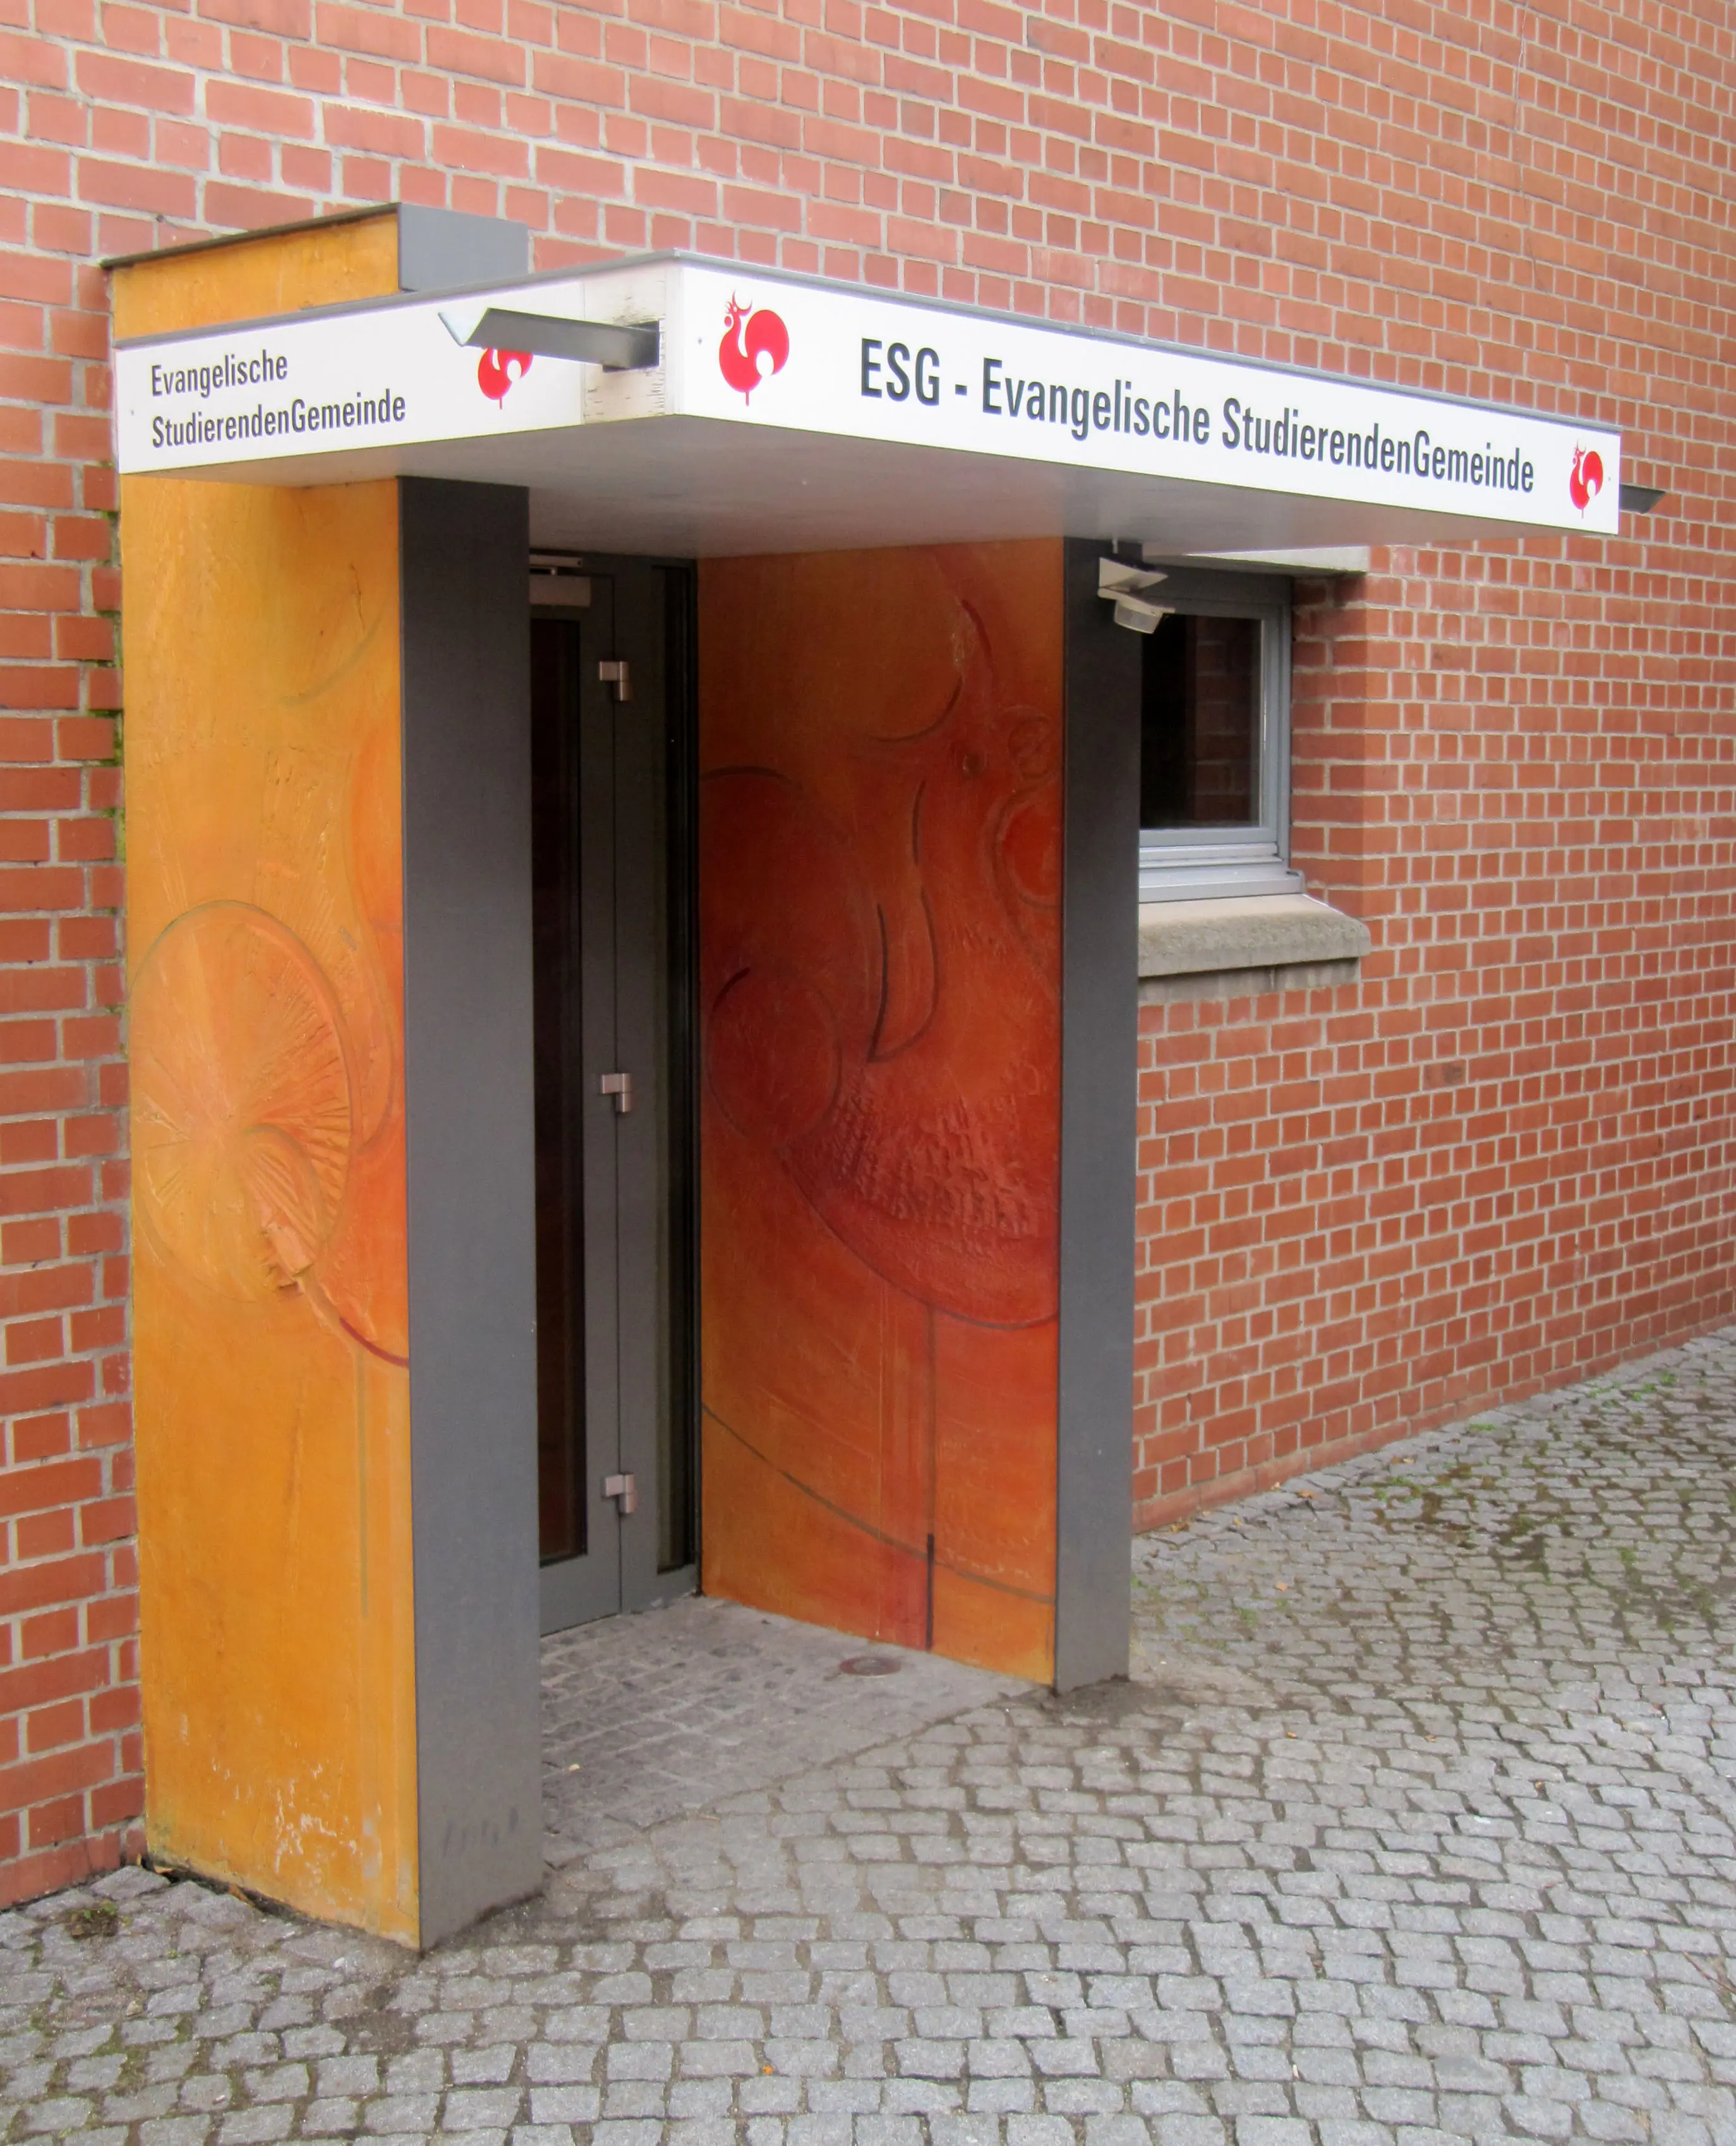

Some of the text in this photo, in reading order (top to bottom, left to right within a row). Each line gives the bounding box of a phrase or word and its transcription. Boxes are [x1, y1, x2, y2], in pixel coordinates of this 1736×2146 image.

[151, 349, 288, 398] Evangelische
[152, 388, 406, 449] StudierendenGemeinde
[860, 337, 1534, 493] ESG - Evangelische StudierendenGemeinde
